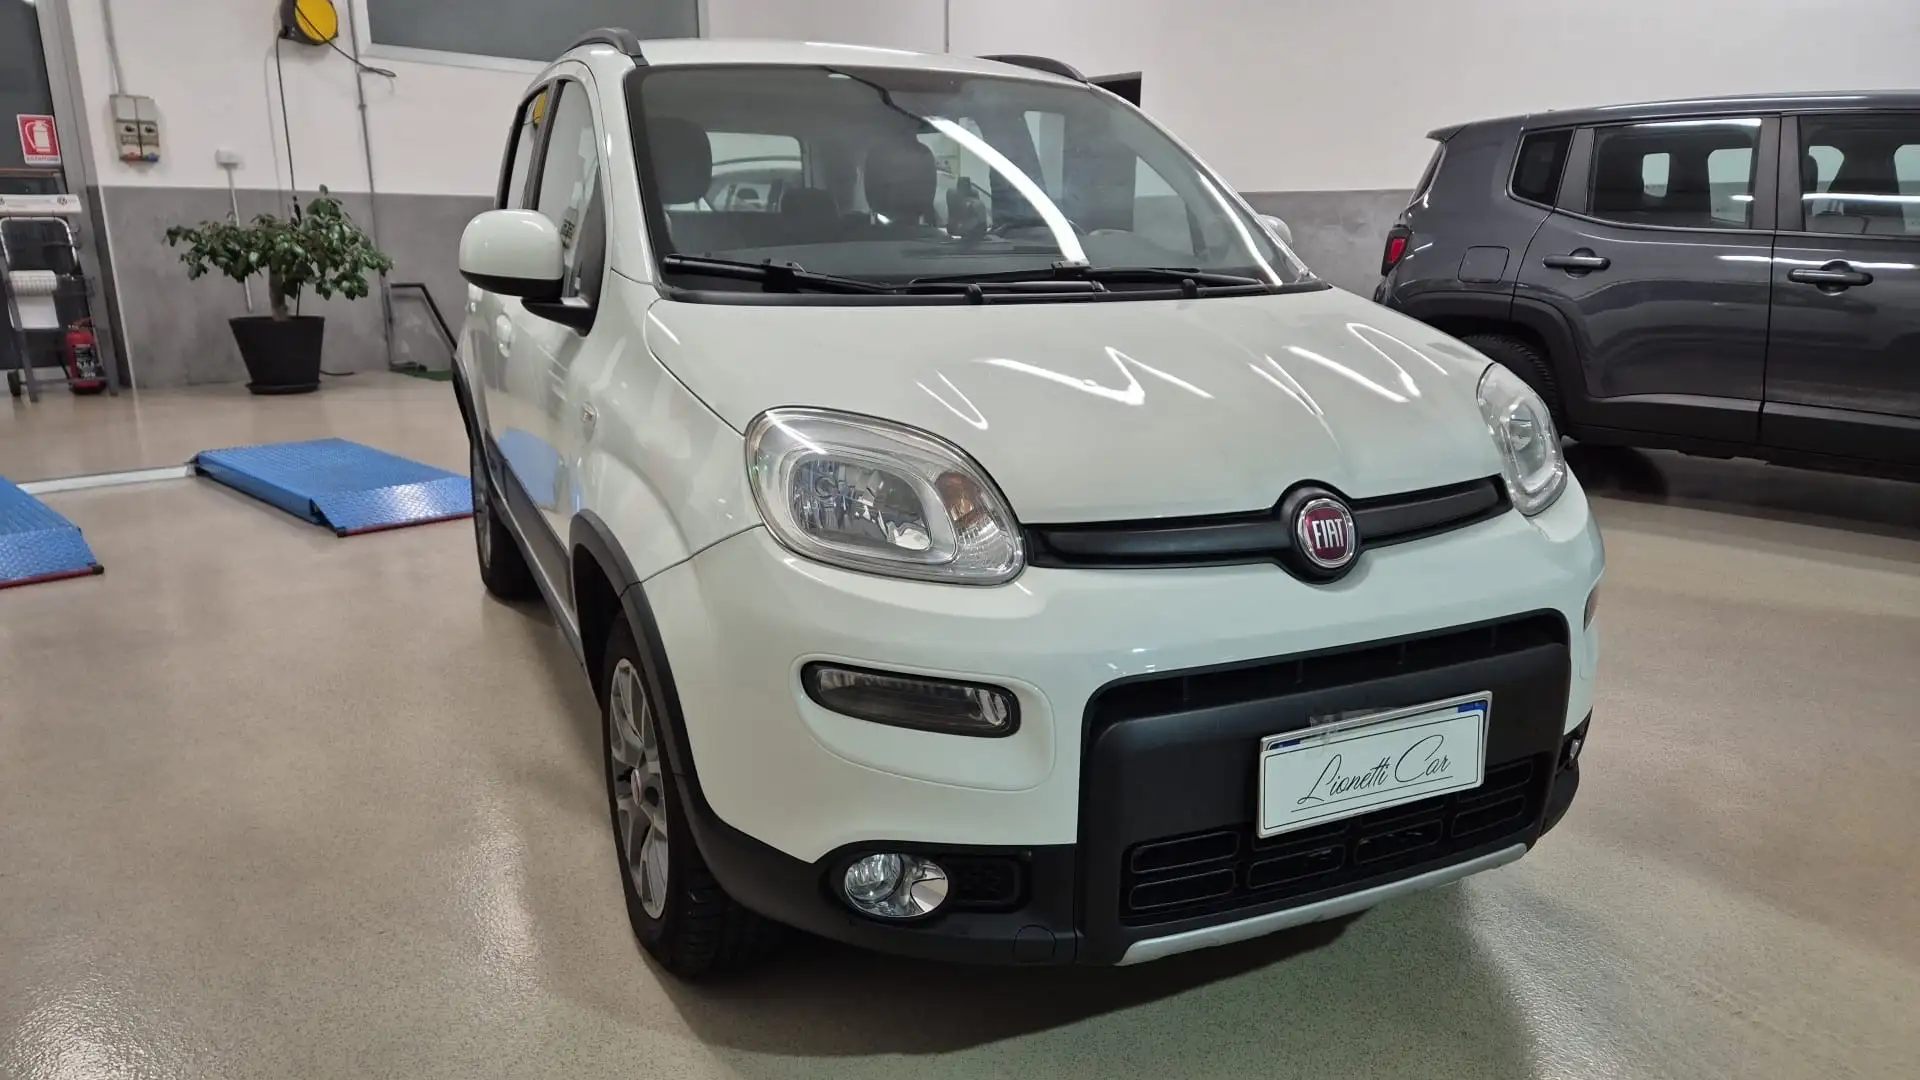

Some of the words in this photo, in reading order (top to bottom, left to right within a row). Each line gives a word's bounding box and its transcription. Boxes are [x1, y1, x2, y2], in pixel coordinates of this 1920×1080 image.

[1311, 518, 1345, 549] FIAT
[1297, 753, 1391, 805] Lionetti
[1394, 734, 1452, 783] Car
